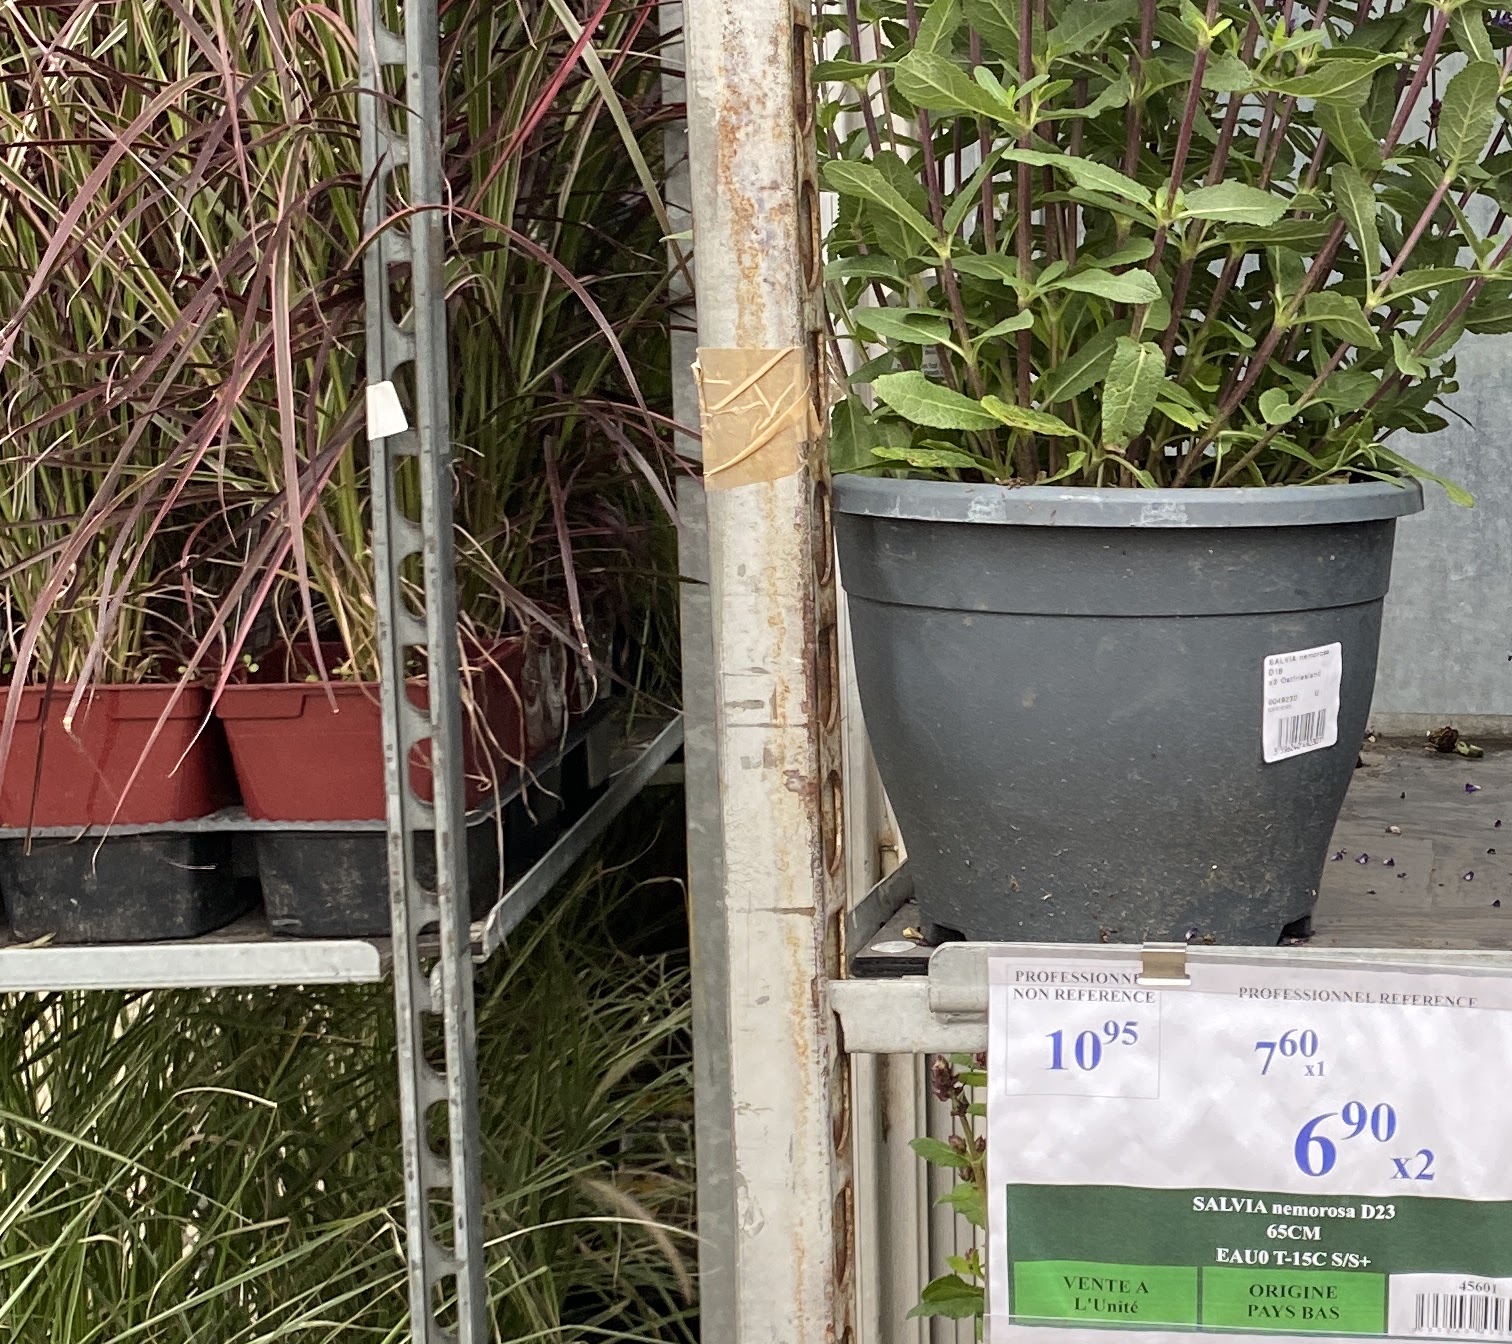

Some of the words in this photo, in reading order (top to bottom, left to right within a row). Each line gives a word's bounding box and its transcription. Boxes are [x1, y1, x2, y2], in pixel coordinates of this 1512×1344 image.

[1269, 656, 1296, 665] SALVIA
[1015, 971, 1140, 985] PROFESSIONNE
[1014, 988, 1049, 1000] NON
[1055, 988, 1155, 1003] REFERENCE
[1239, 987, 1374, 1004] PROFESSIONNEL
[1380, 993, 1478, 1008] REFERENCE
[1304, 1061, 1324, 1076] x1
[1390, 1149, 1435, 1182] x2
[1193, 1197, 1268, 1214] SALVIA
[1272, 1204, 1355, 1218] nemorosa
[1361, 1204, 1395, 1219] D23
[1267, 1224, 1321, 1240] 65CM
[1273, 1251, 1326, 1266] T-15C
[1332, 1253, 1371, 1268] S/S+
[1063, 1276, 1130, 1293] VENTE
[1136, 1281, 1148, 1293] A
[1250, 1283, 1337, 1299] ORIGINE
[1459, 1281, 1497, 1294] 45601
[1075, 1297, 1138, 1314] L'Unité
[1248, 1305, 1295, 1319] PAYS
[1302, 1306, 1339, 1320] BAS
